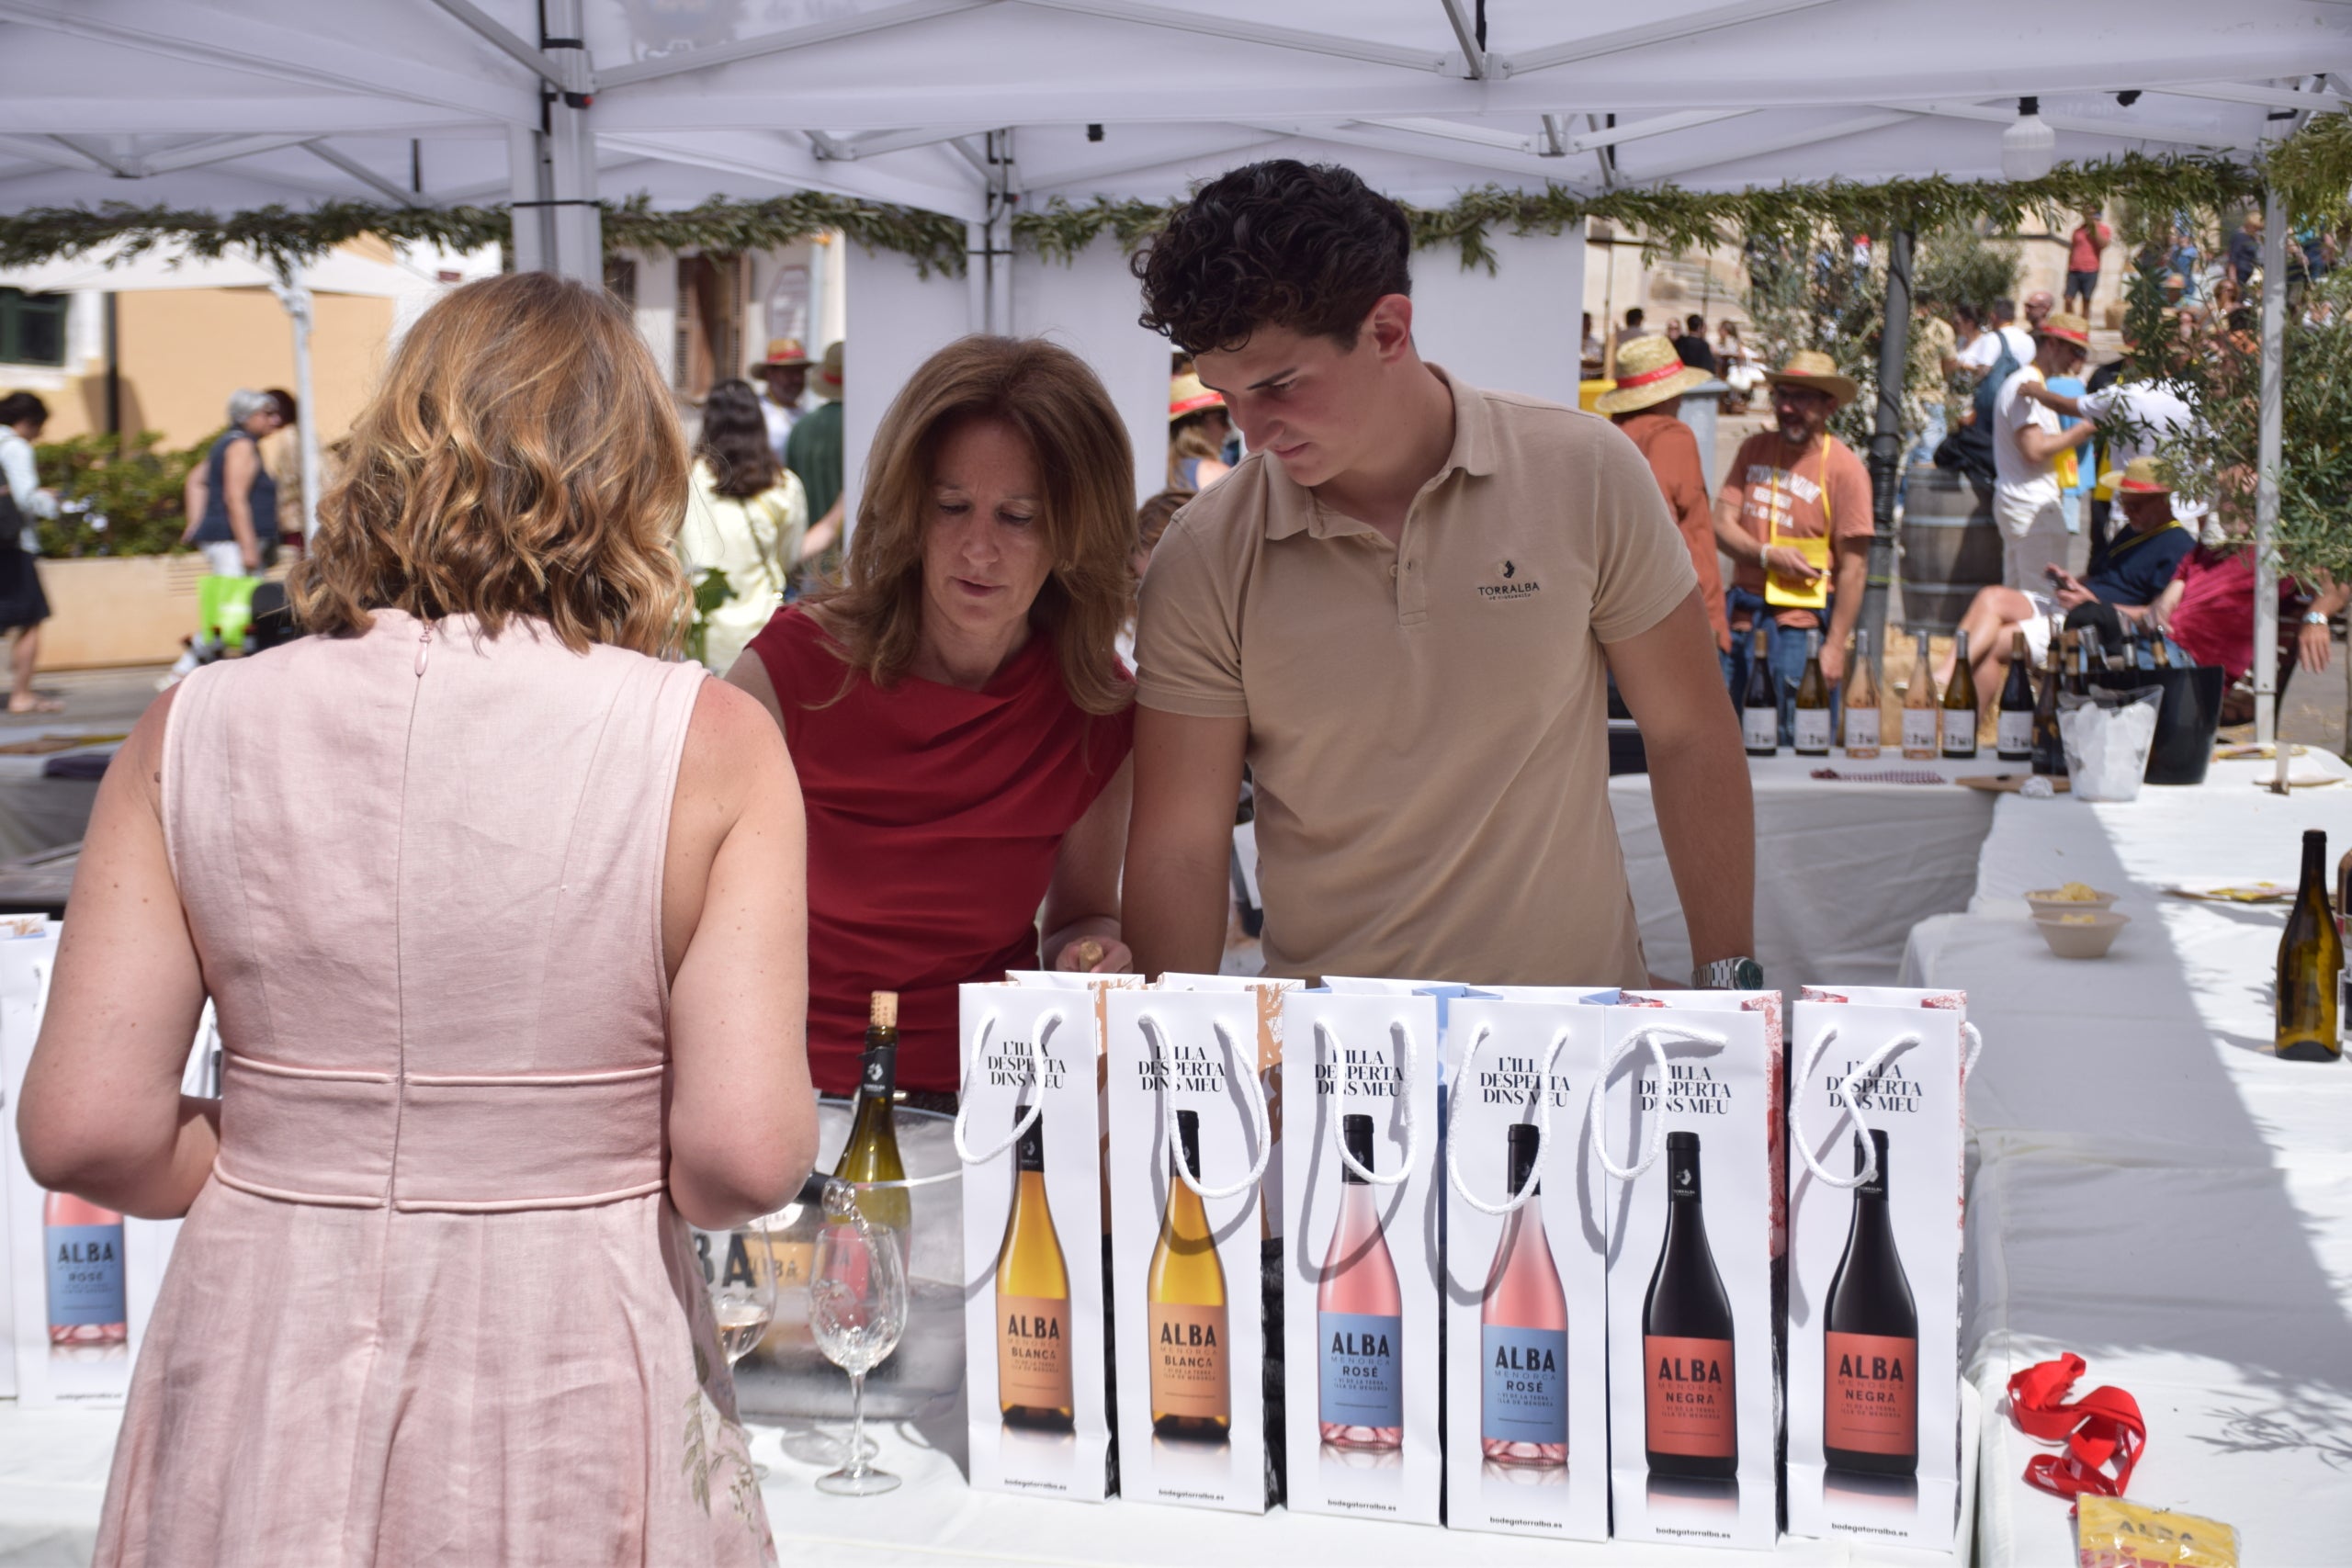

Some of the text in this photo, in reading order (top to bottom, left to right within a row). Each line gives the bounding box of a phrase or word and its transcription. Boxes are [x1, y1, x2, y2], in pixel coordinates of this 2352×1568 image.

[1477, 581, 1540, 596] TORRALBA
[988, 1055, 1066, 1073] DESPETA
[1315, 1064, 1404, 1081] DEPERTA
[1498, 1056, 1551, 1074] L'ILL
[991, 1071, 1026, 1087] DINS
[1185, 1077, 1223, 1092] MEU
[1826, 1076, 1923, 1097] DSPERTA
[1317, 1079, 1401, 1097] DIS MEU
[1484, 1089, 1524, 1105] DINS
[1878, 1096, 1919, 1113] MEU
[1689, 1098, 1729, 1115] MEU
[57, 1241, 115, 1263] ALBA
[1008, 1314, 1060, 1339] ALBA
[1159, 1322, 1217, 1348] ALBA
[1012, 1347, 1057, 1359] BLANCA
[1331, 1332, 1389, 1358] ALBA
[1165, 1355, 1213, 1368] BLANCA
[1496, 1346, 1555, 1372] ALBA
[1342, 1365, 1378, 1378] ROSÉ
[1658, 1358, 1722, 1384] ALBA
[1839, 1354, 1904, 1382] ALBA
[1507, 1381, 1544, 1393] ROSÉ
[1666, 1392, 1714, 1404] NEGRA
[1845, 1389, 1896, 1404] NEGRA
[1831, 1523, 1908, 1537] bodegatorralba.es
